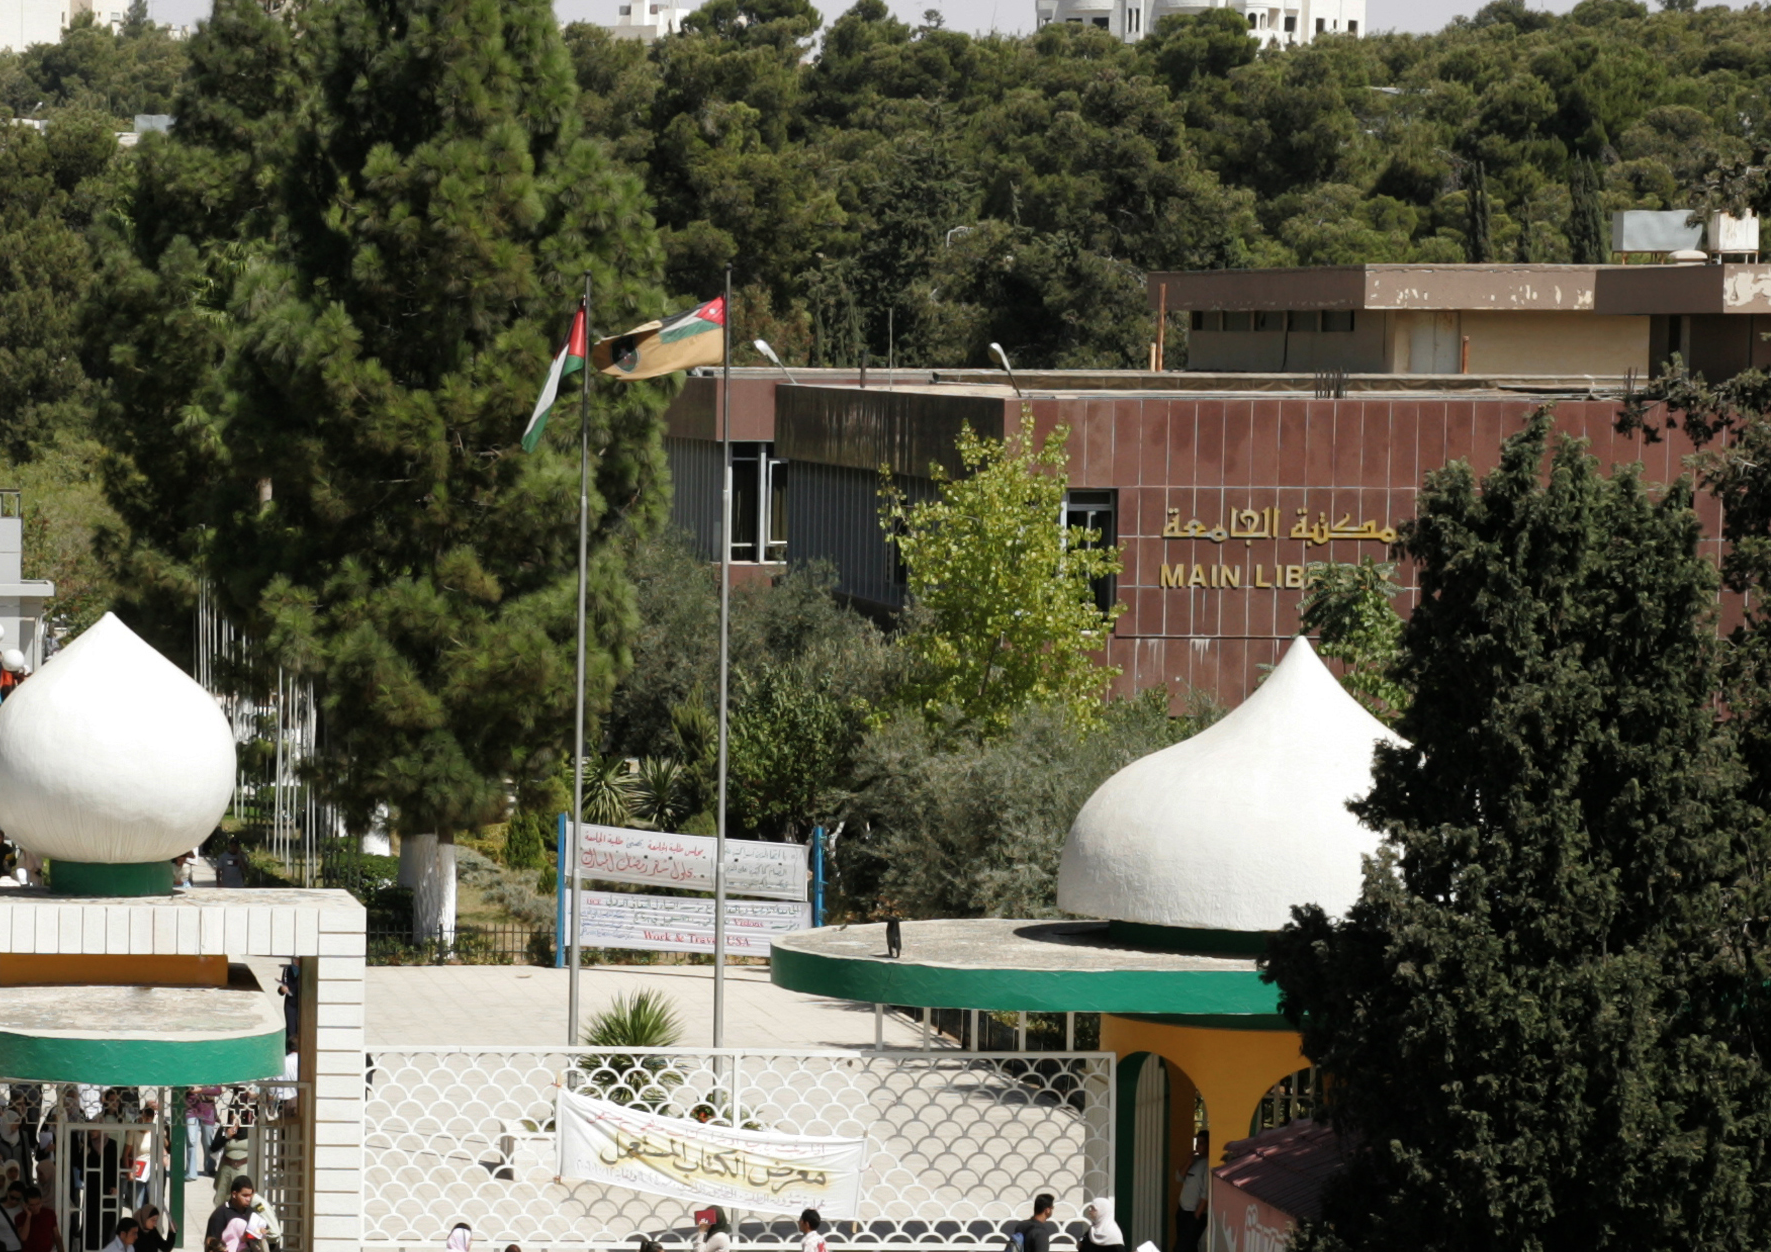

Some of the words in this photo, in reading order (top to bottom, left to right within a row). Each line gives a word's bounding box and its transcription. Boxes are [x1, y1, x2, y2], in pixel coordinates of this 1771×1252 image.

[1162, 506, 1279, 548] الجامعة
[1290, 508, 1397, 548] مكتبة
[1160, 564, 1241, 588] MAIN
[643, 930, 672, 942] Work
[689, 933, 718, 945] Trave
[599, 1131, 687, 1166] المستعمل
[672, 1145, 746, 1180] الكتاب
[748, 1160, 827, 1195] معرض
